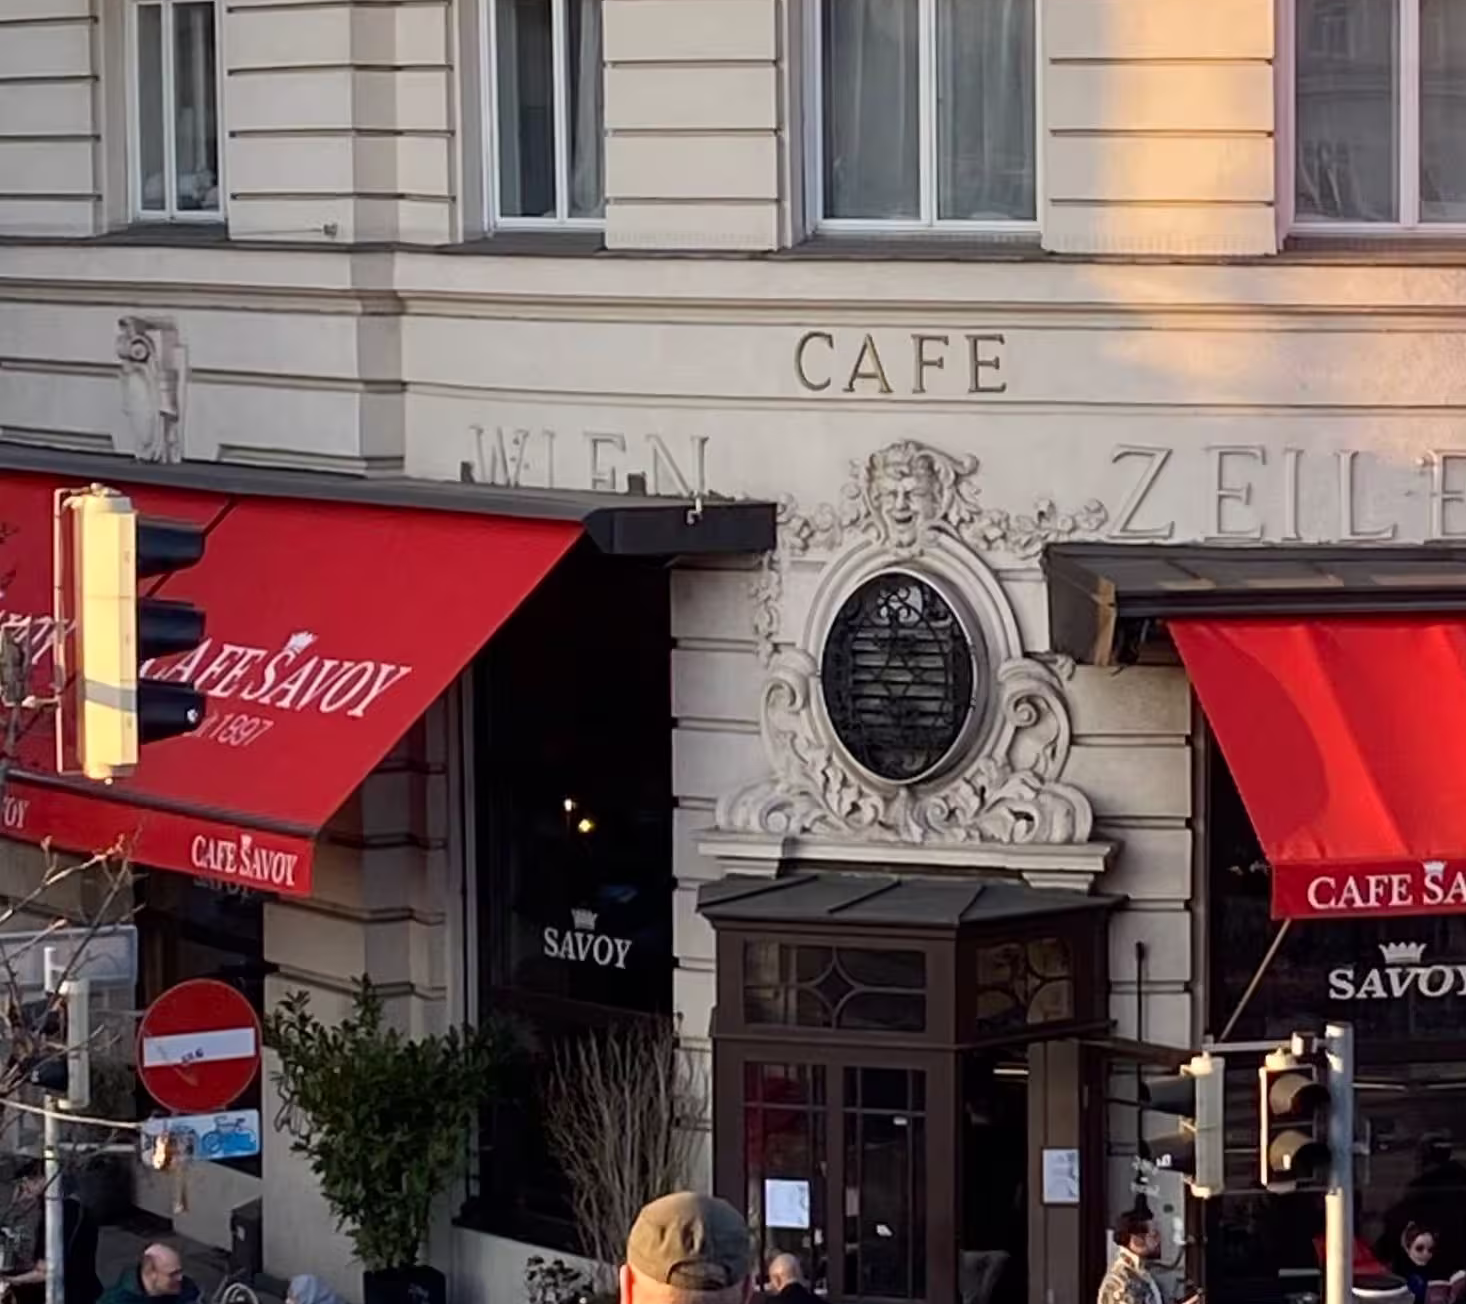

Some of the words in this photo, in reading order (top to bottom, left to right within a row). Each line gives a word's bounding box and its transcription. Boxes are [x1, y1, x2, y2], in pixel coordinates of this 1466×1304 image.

[793, 330, 1008, 395] CAFE
[468, 424, 710, 498] WIEN
[240, 649, 412, 718] SAVOY
[190, 834, 237, 874] CAFE
[238, 844, 299, 887] SAVOY
[1306, 873, 1414, 910] CAFE
[543, 926, 633, 970] SAVOY
